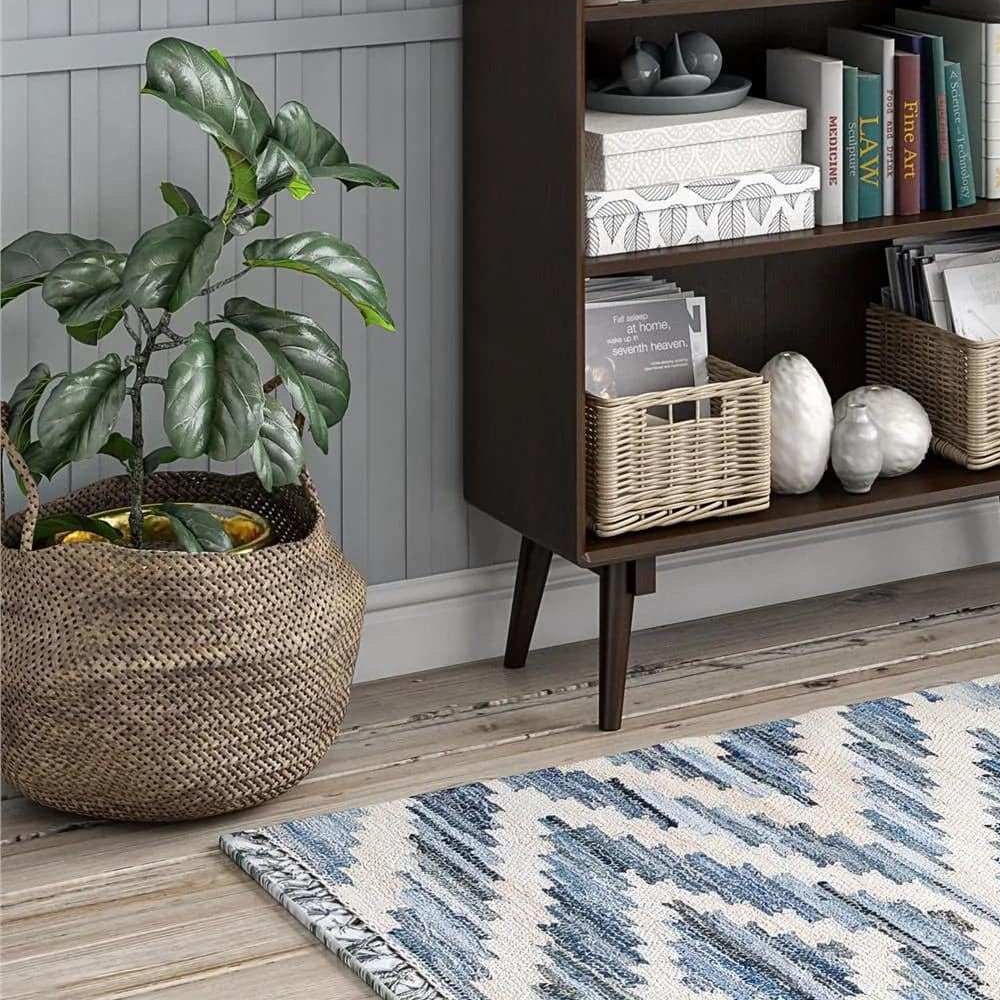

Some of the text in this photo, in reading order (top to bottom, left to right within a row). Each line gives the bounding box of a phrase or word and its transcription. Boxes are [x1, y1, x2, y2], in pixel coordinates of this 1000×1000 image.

[828, 115, 838, 186] MEDICINE
[846, 121, 858, 177] Sculpture
[859, 115, 881, 188] LAW
[886, 89, 894, 178] Food and Drink
[903, 99, 919, 180] Fine Art
[950, 81, 963, 123] Science
[957, 134, 971, 199] Technology
[612, 339, 689, 356] seventh heaven.
[626, 325, 637, 334] at
